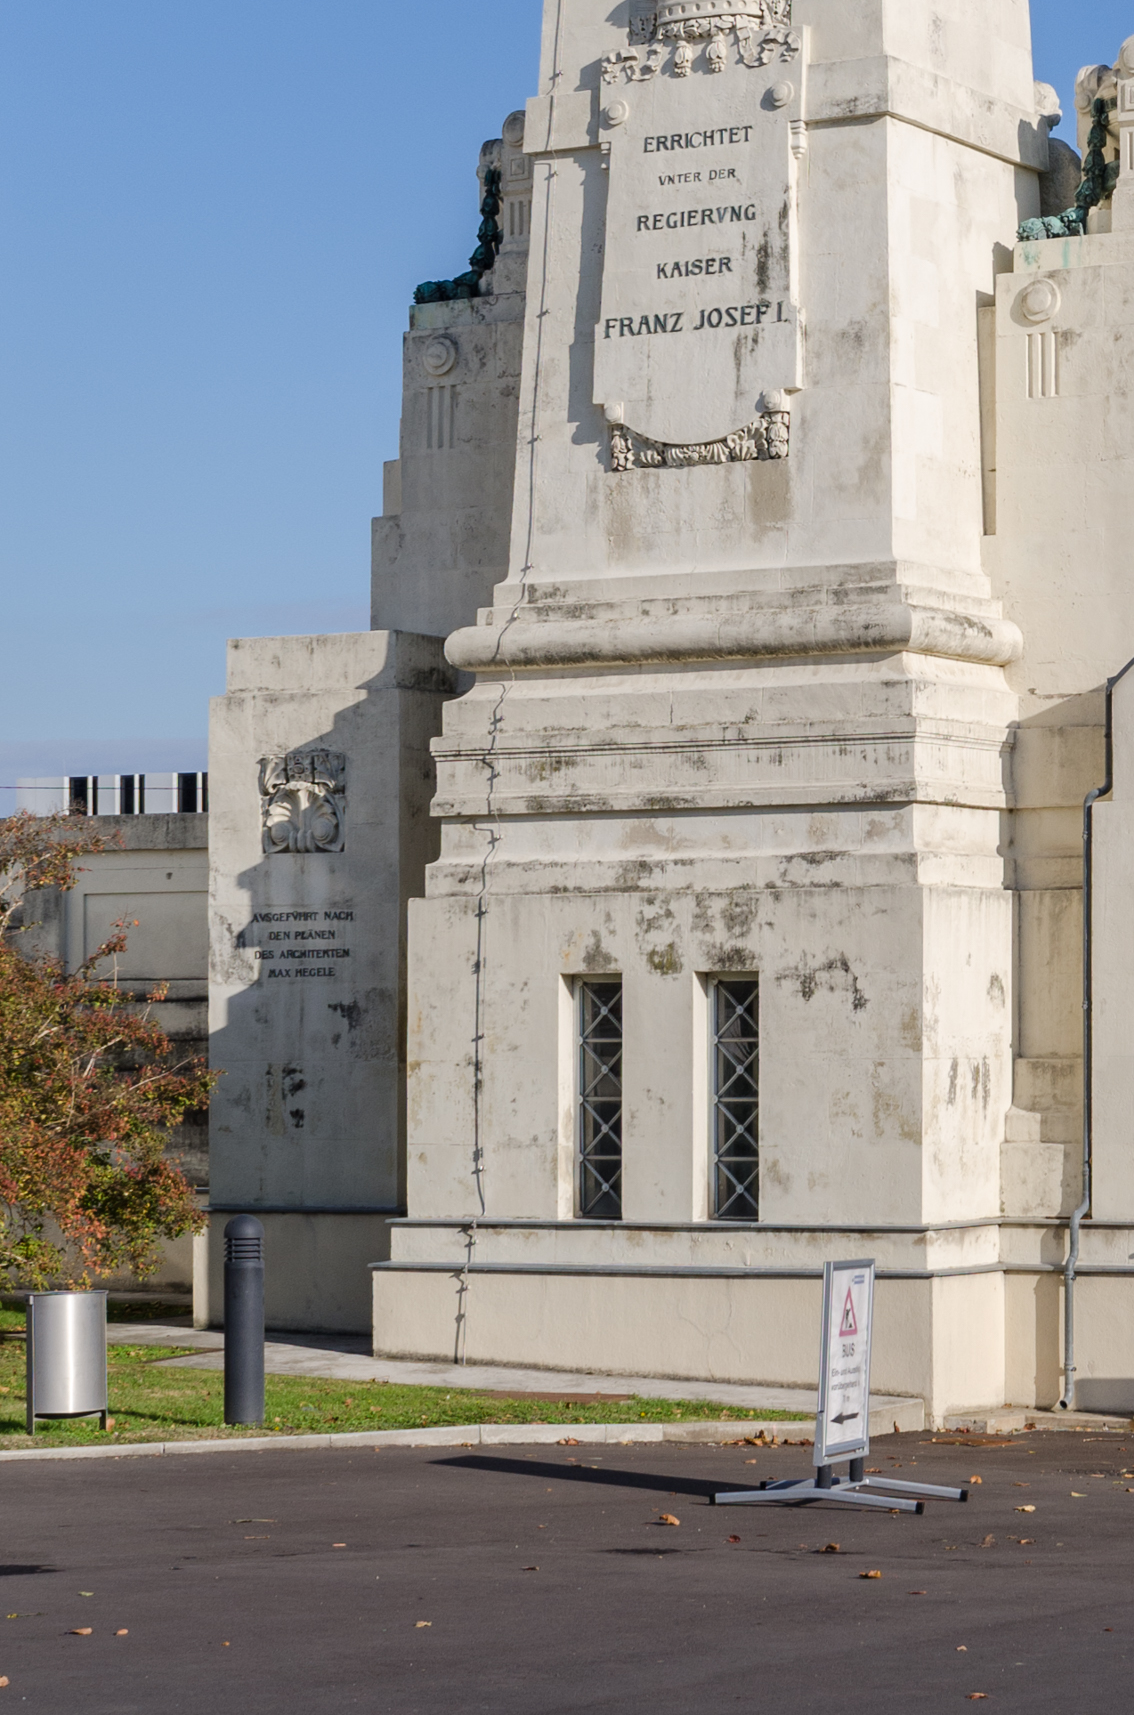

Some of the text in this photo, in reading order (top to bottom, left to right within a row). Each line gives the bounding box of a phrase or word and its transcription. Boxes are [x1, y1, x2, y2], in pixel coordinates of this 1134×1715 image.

[643, 125, 753, 153] ERRICHTET
[658, 168, 736, 186] VNTER DER
[636, 203, 757, 232] REGIERVNG
[656, 256, 733, 280] KAISER
[602, 311, 685, 339] FRANZ
[693, 302, 772, 331] JOSEF
[323, 911, 354, 921] NACH
[269, 929, 336, 941] DEN PLÄNEN
[254, 948, 350, 960] DES ARCHITEKTEN
[268, 967, 336, 978] MAX HEGELE
[842, 1342, 856, 1358] BUS
